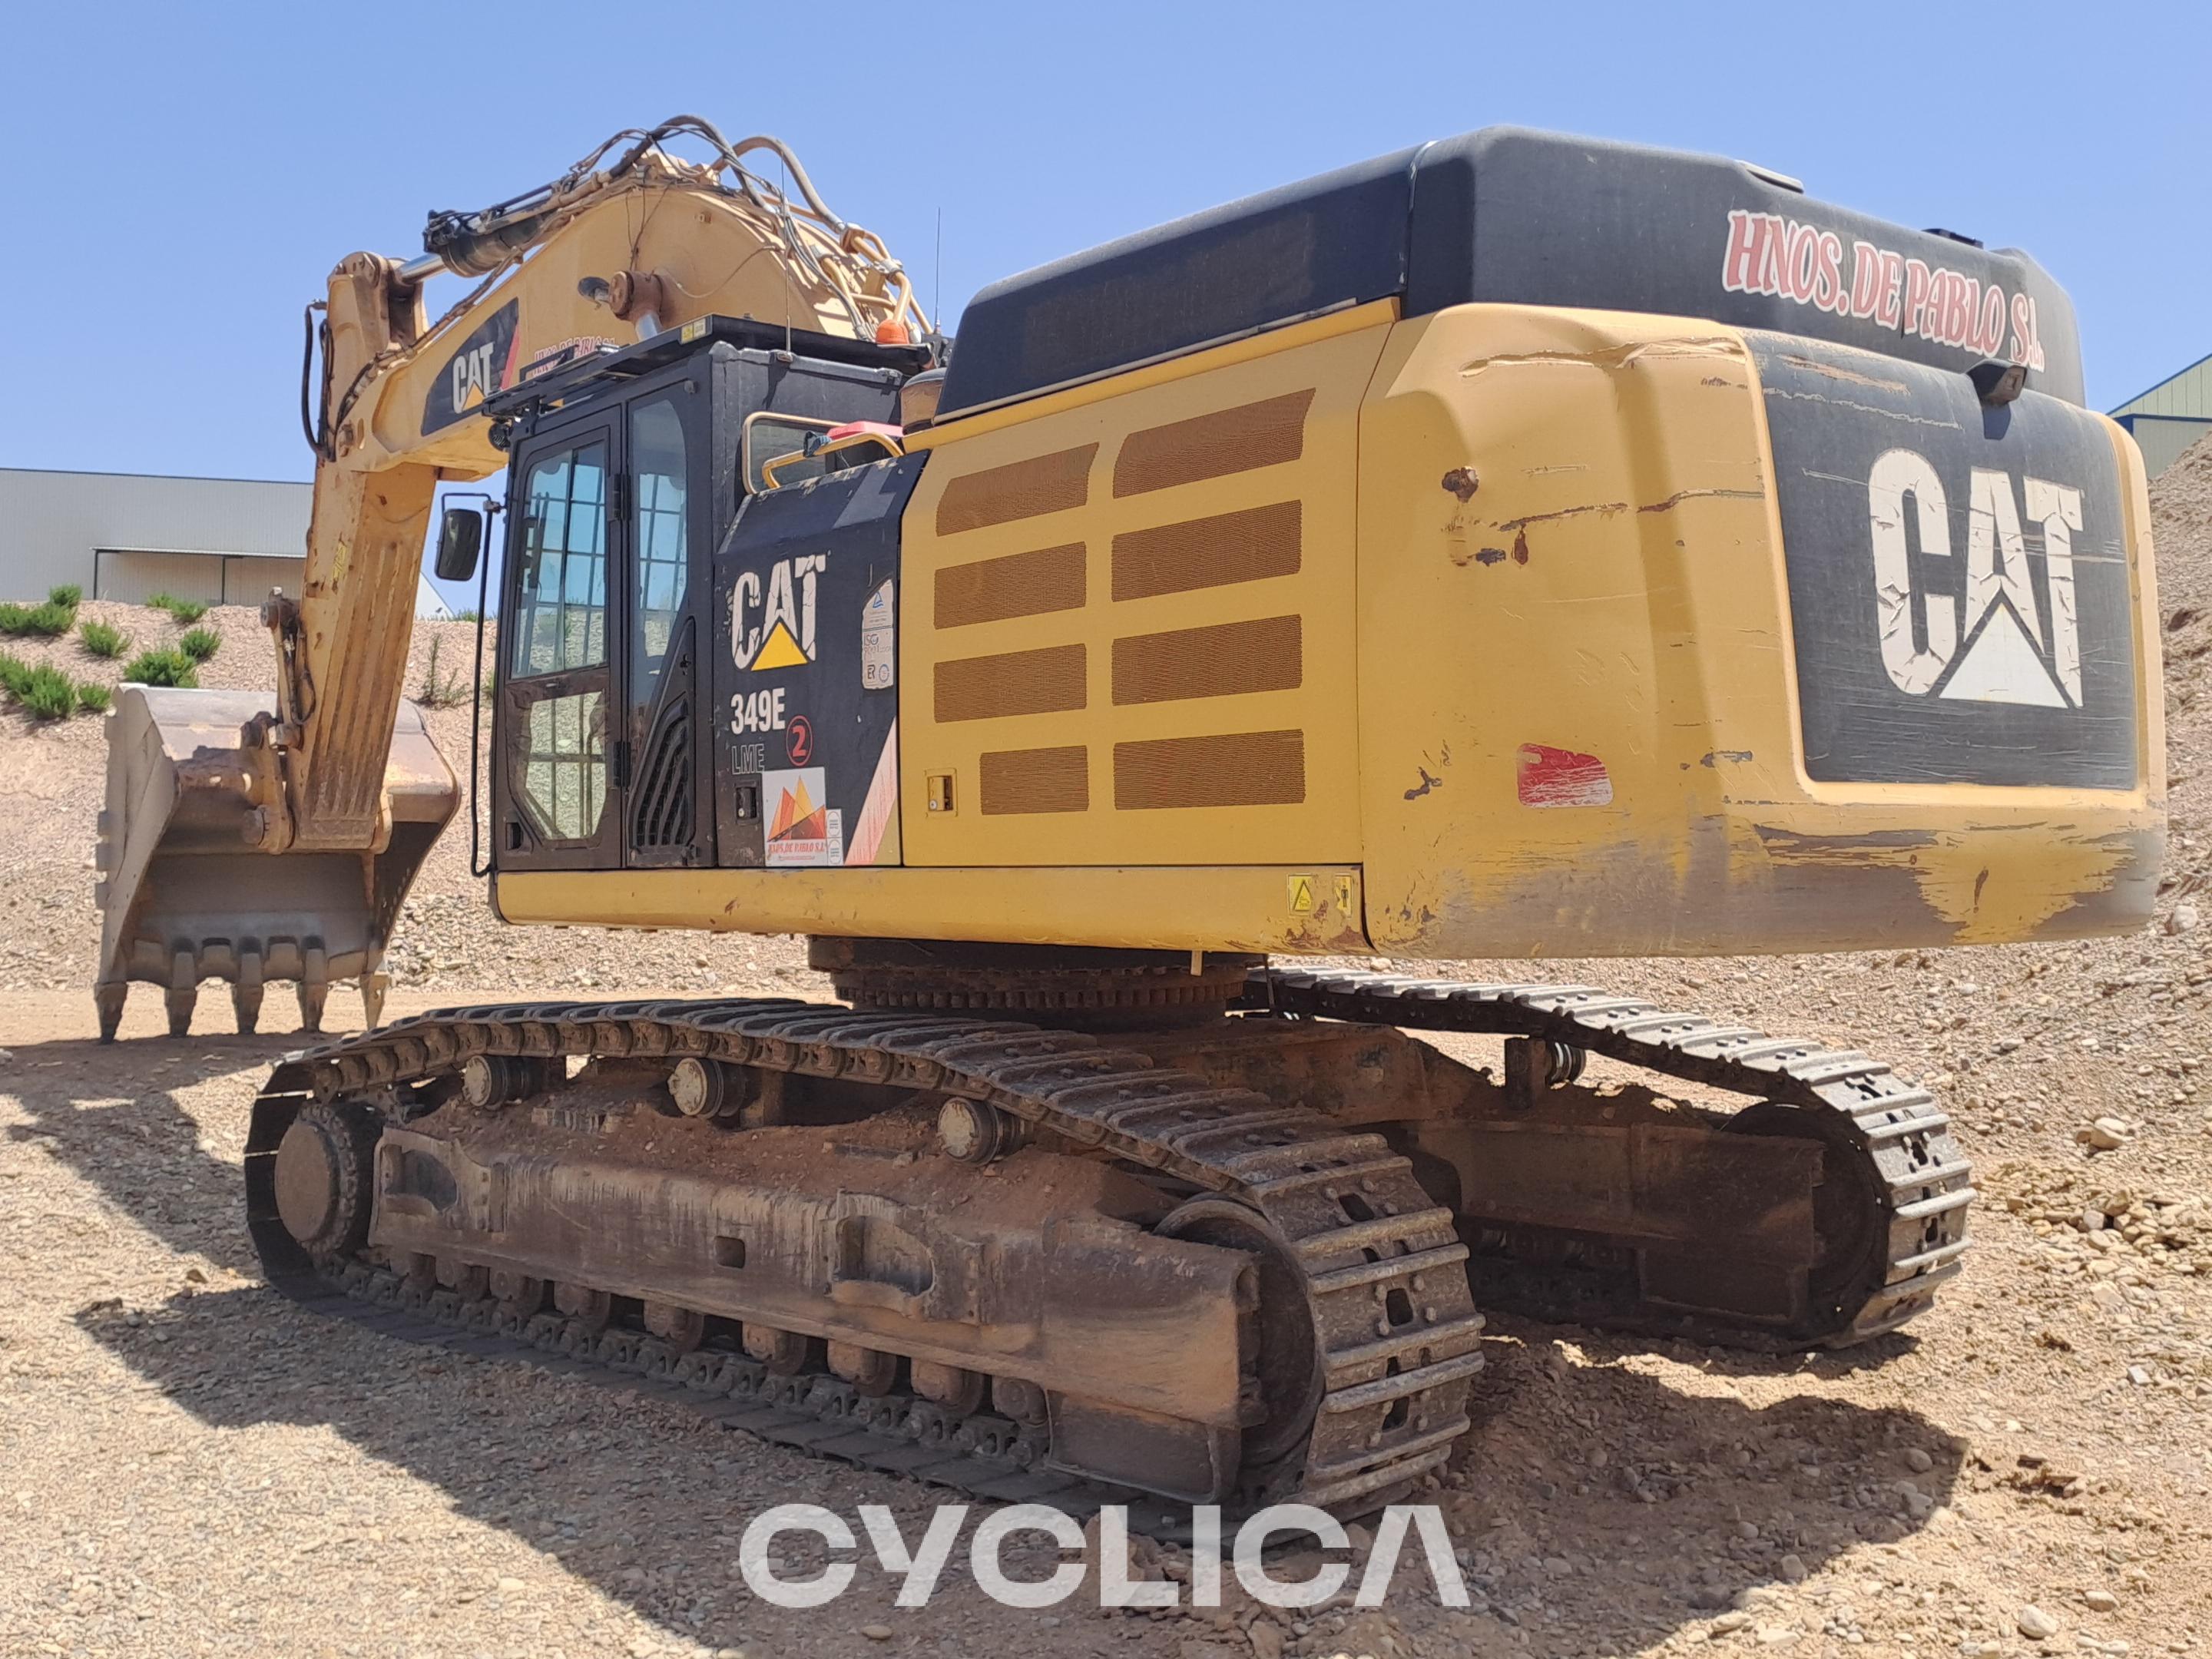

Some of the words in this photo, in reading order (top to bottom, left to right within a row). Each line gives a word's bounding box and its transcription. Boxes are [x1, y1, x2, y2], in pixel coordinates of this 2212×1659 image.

[1722, 209, 1849, 317] HNOS.
[1852, 240, 1905, 331] DE
[1903, 258, 2006, 359] PABLO
[452, 342, 495, 414] CAT
[731, 554, 826, 671] CAT
[1867, 447, 2086, 709] CAT
[730, 687, 786, 735] 349E
[792, 724, 807, 758] 2
[731, 743, 765, 775] LME
